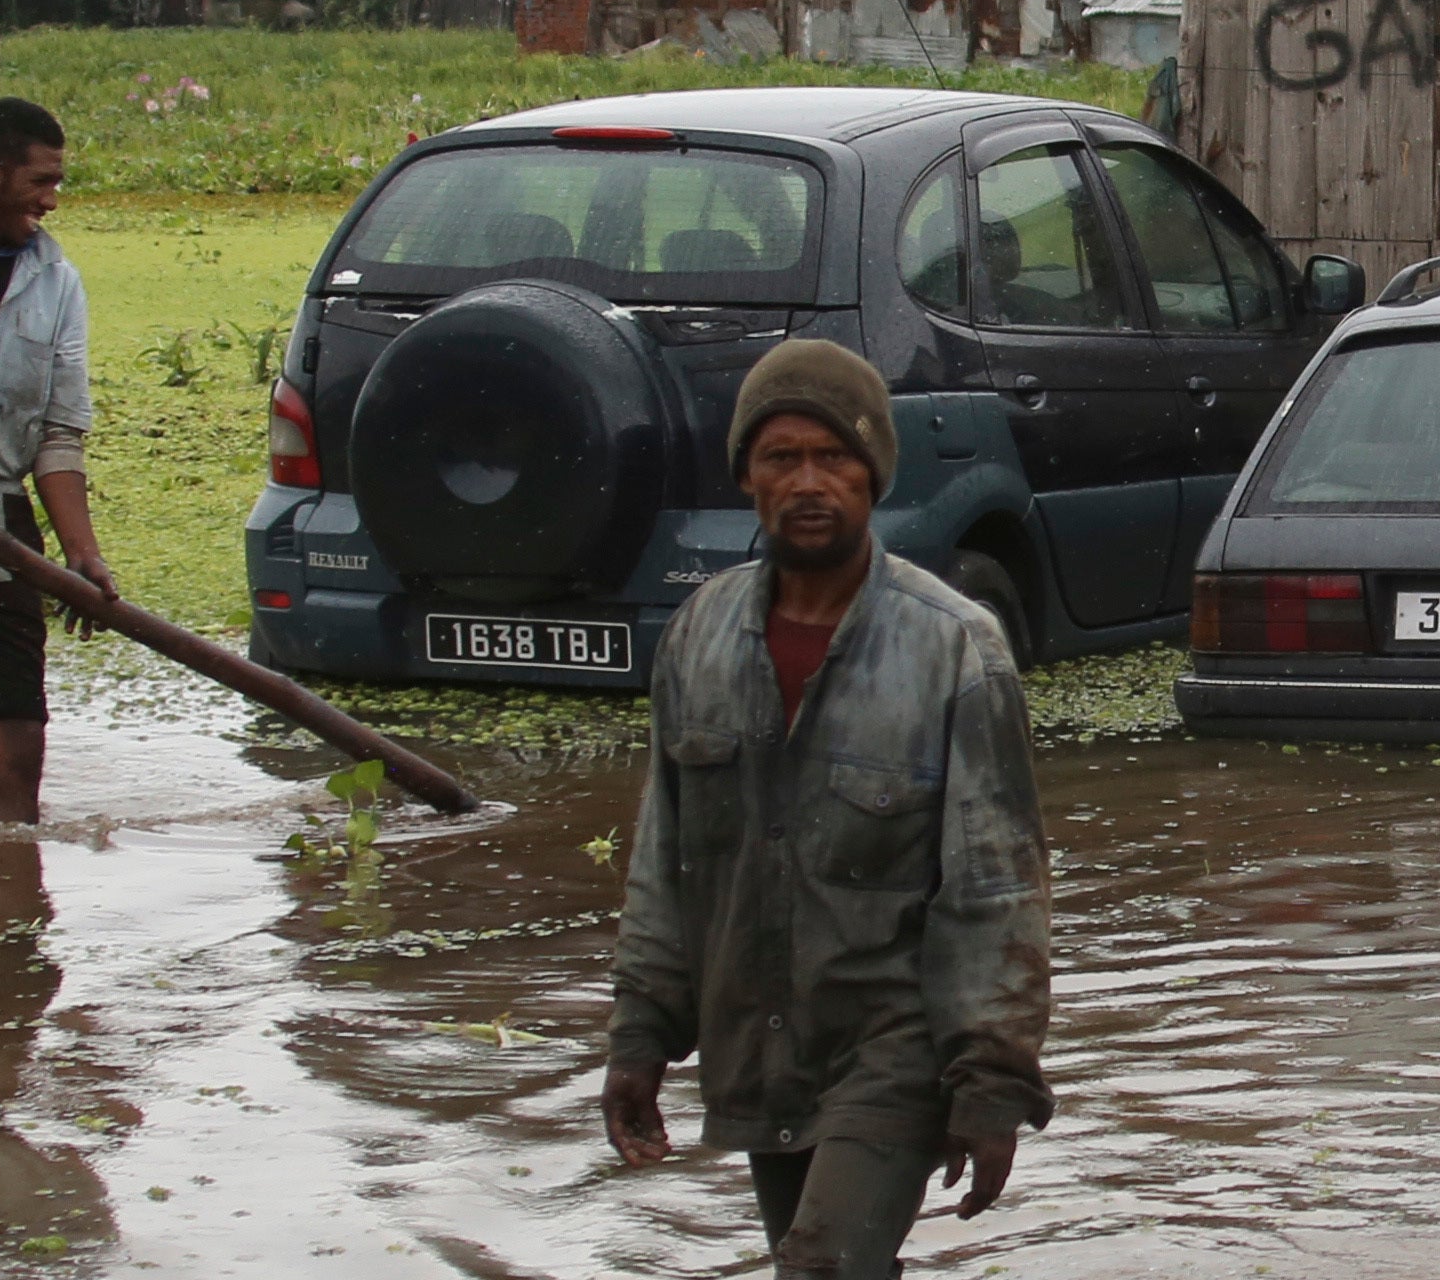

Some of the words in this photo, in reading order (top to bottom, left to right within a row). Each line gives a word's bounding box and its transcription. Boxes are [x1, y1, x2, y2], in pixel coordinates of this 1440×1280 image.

[308, 551, 369, 570] RENAULT
[452, 622, 536, 659] 1638
[546, 626, 611, 664] TBJ
